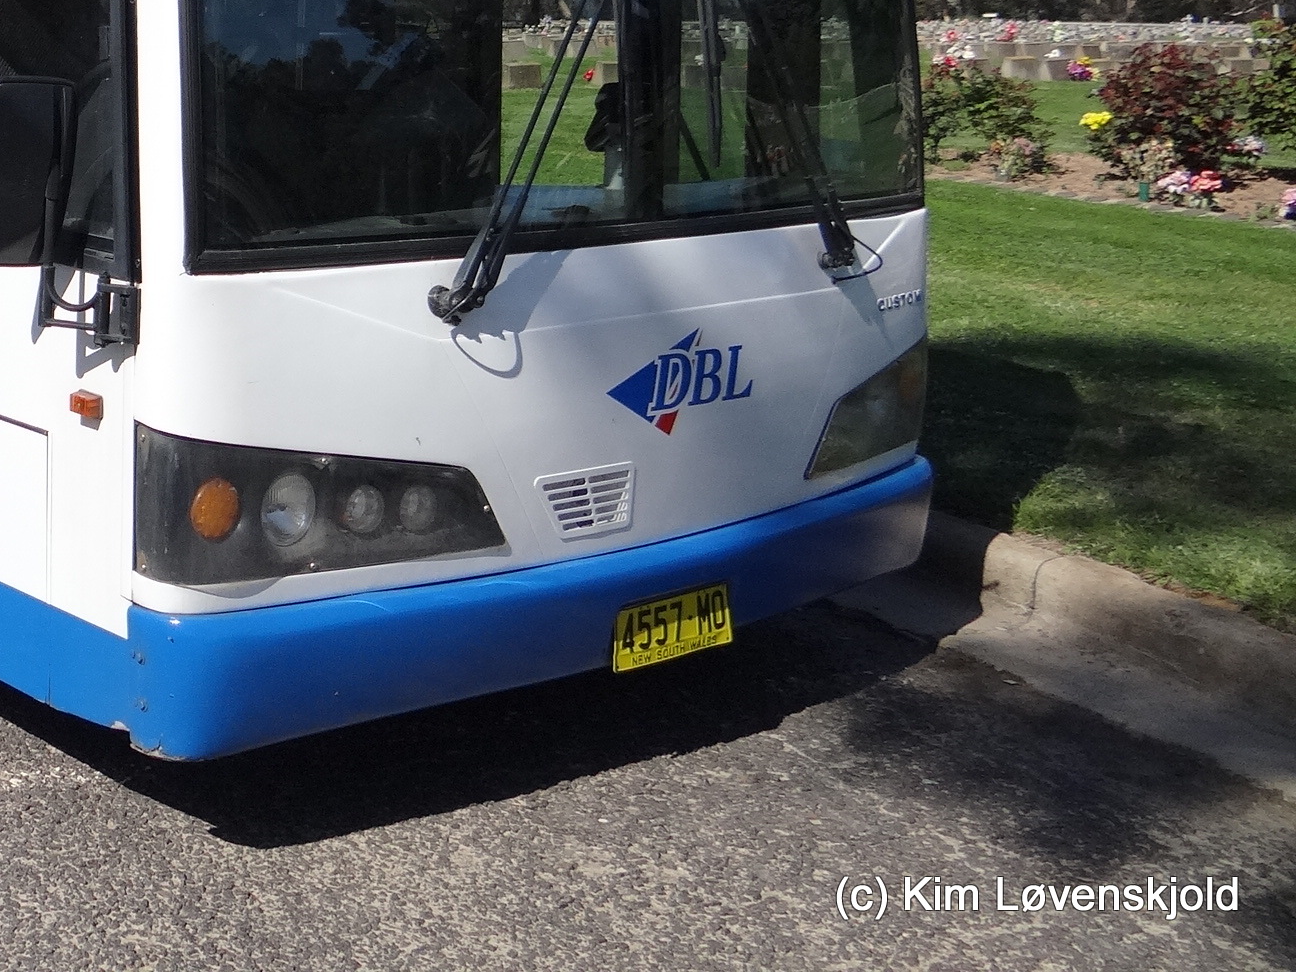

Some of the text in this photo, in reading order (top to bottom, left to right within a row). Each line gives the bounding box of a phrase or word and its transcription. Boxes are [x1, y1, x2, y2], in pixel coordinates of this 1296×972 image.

[650, 344, 754, 413] DBL
[632, 634, 717, 666] NEW SOUTH WALES
